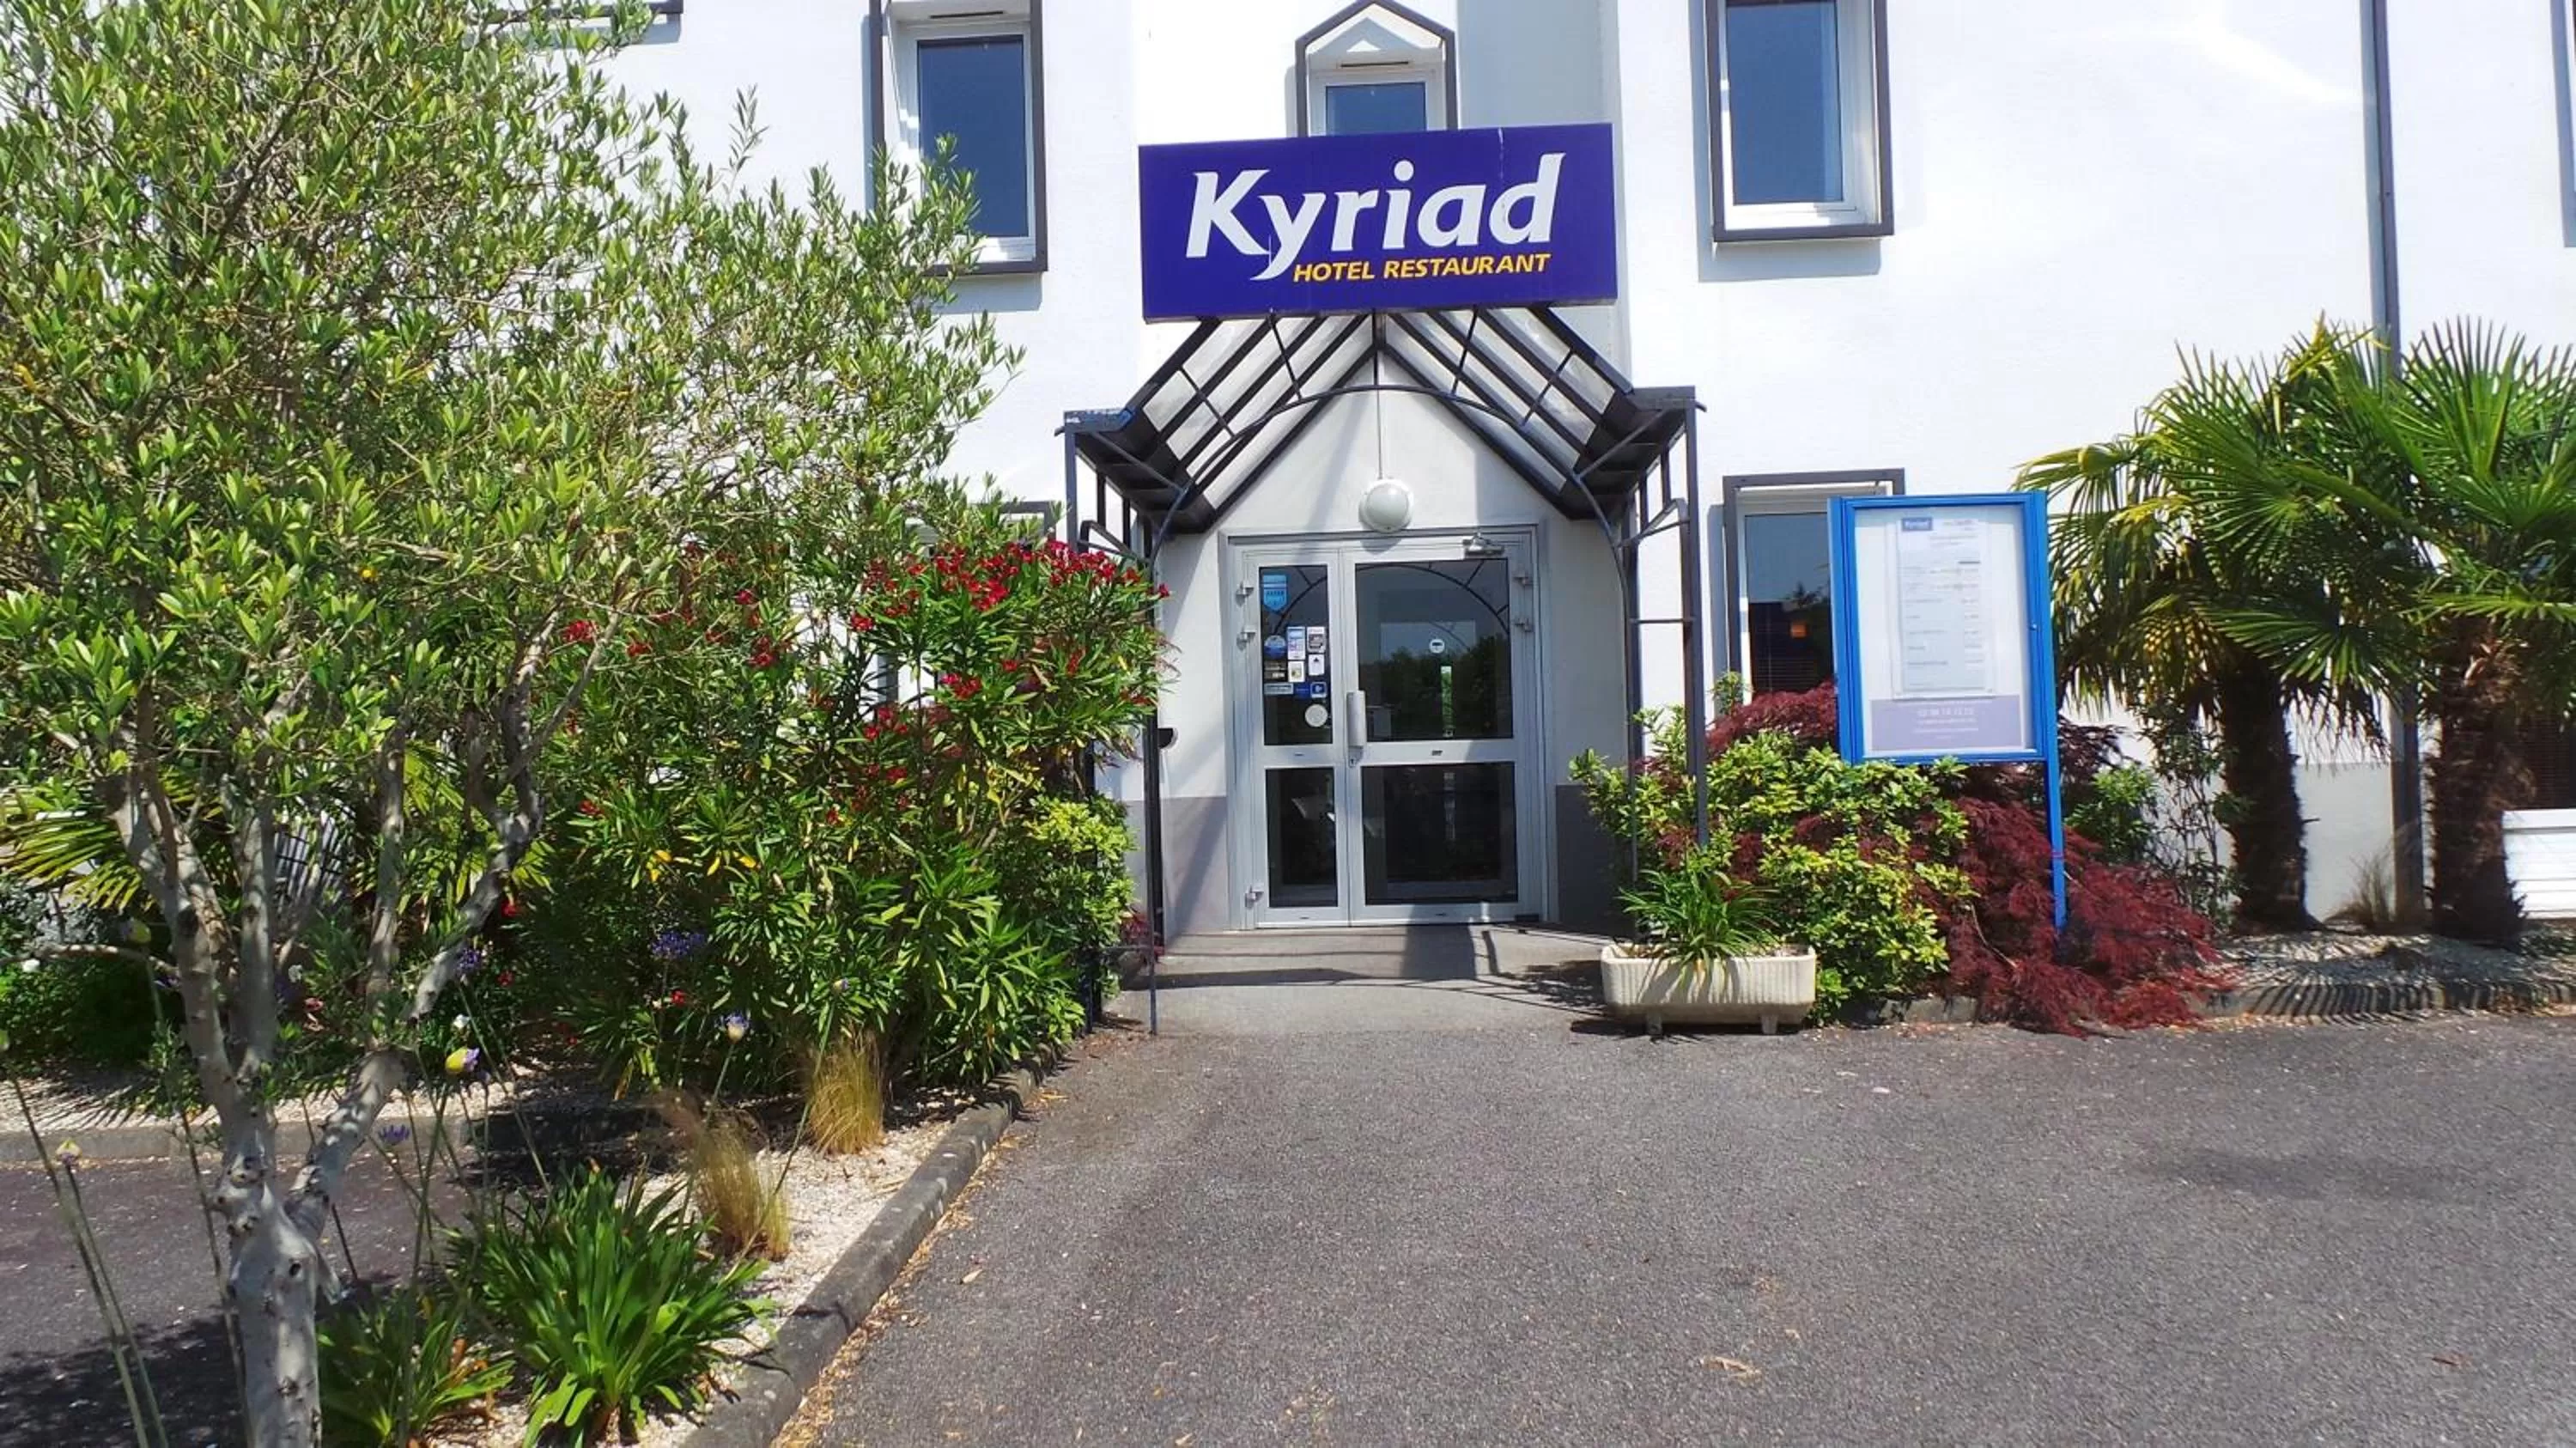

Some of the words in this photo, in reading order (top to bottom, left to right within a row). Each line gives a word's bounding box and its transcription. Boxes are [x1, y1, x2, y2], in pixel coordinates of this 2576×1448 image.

[1187, 153, 1566, 281] Kyriad
[1293, 261, 1376, 282] HOTEL
[1383, 253, 1552, 278] RESTAURANT
